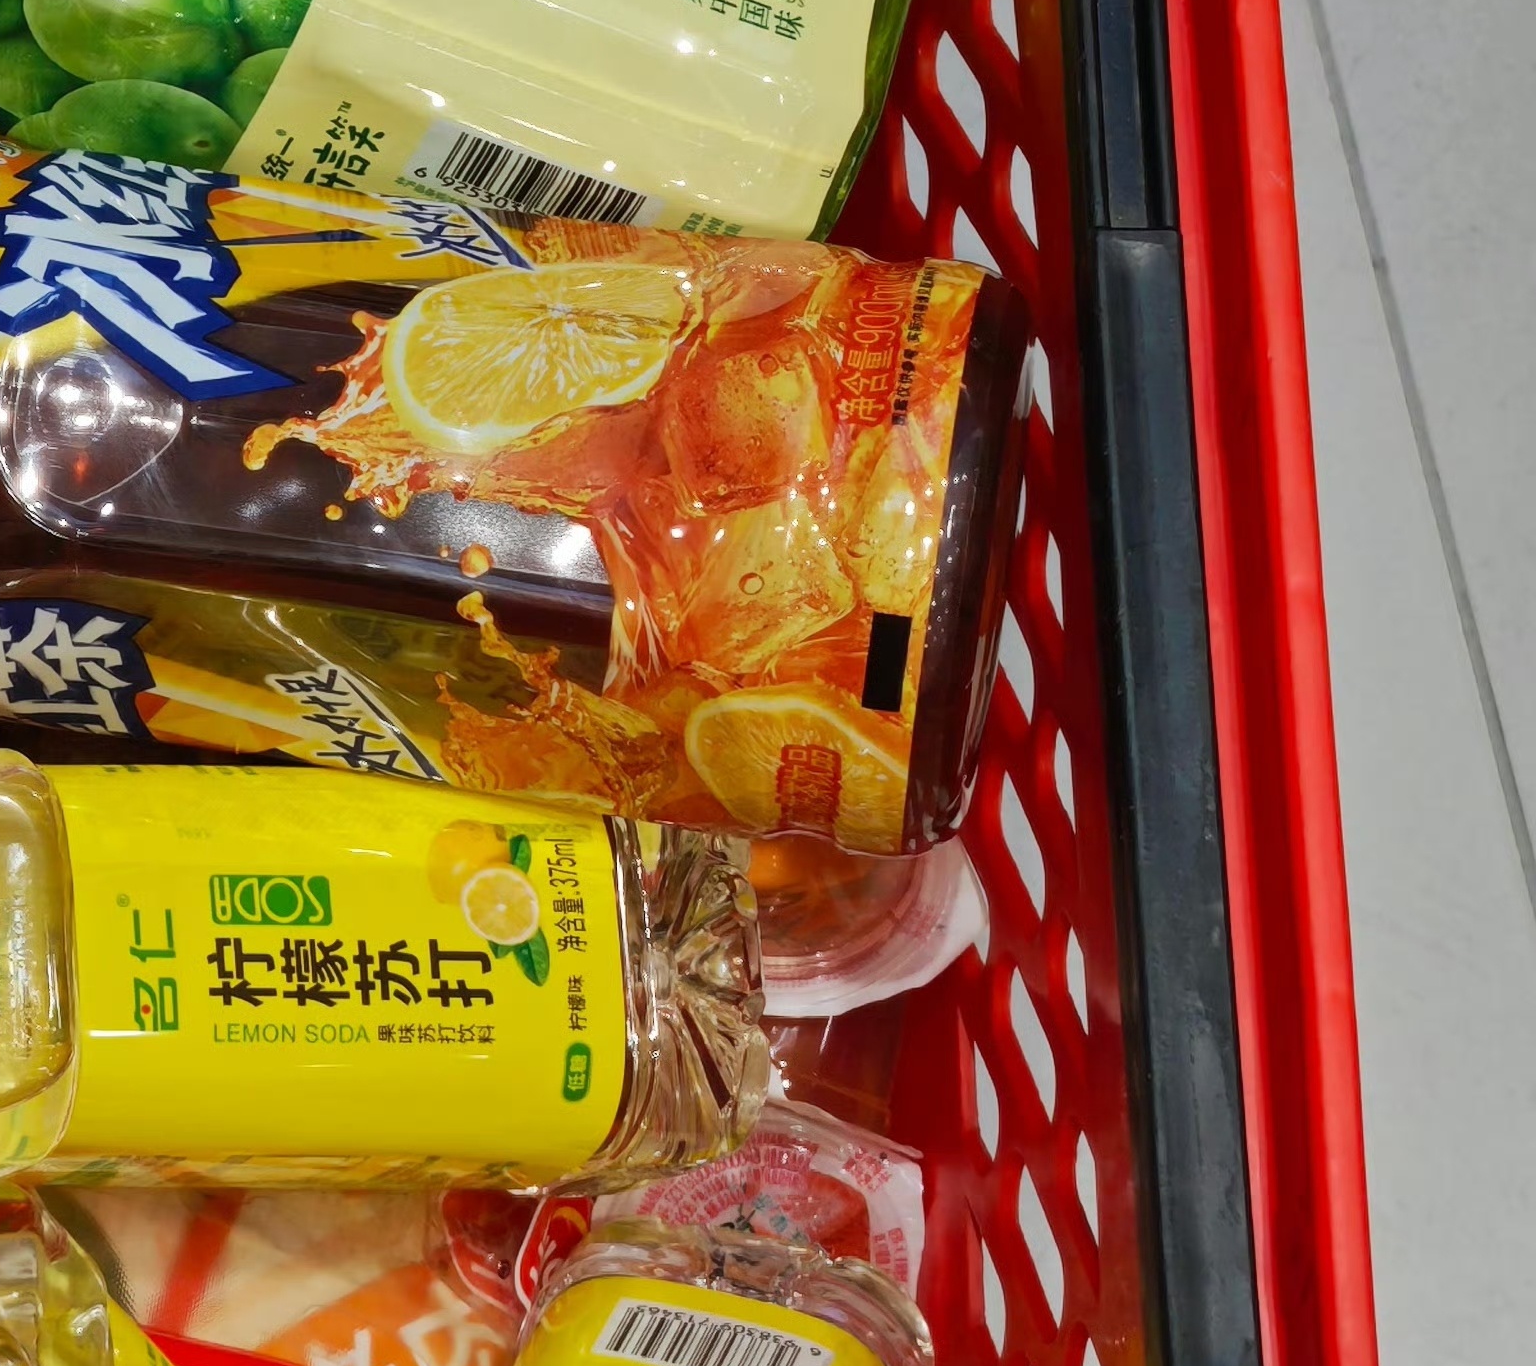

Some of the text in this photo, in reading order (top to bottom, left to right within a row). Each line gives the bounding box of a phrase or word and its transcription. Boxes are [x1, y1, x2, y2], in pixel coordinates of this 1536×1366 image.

[211, 877, 330, 924] SODA
[553, 835, 588, 954] 净含量:375ml
[128, 907, 179, 1032] 名仁
[208, 937, 495, 1009] 柠檬苏打
[213, 1022, 497, 1045] LEMON SODA 果味苏打饮料
